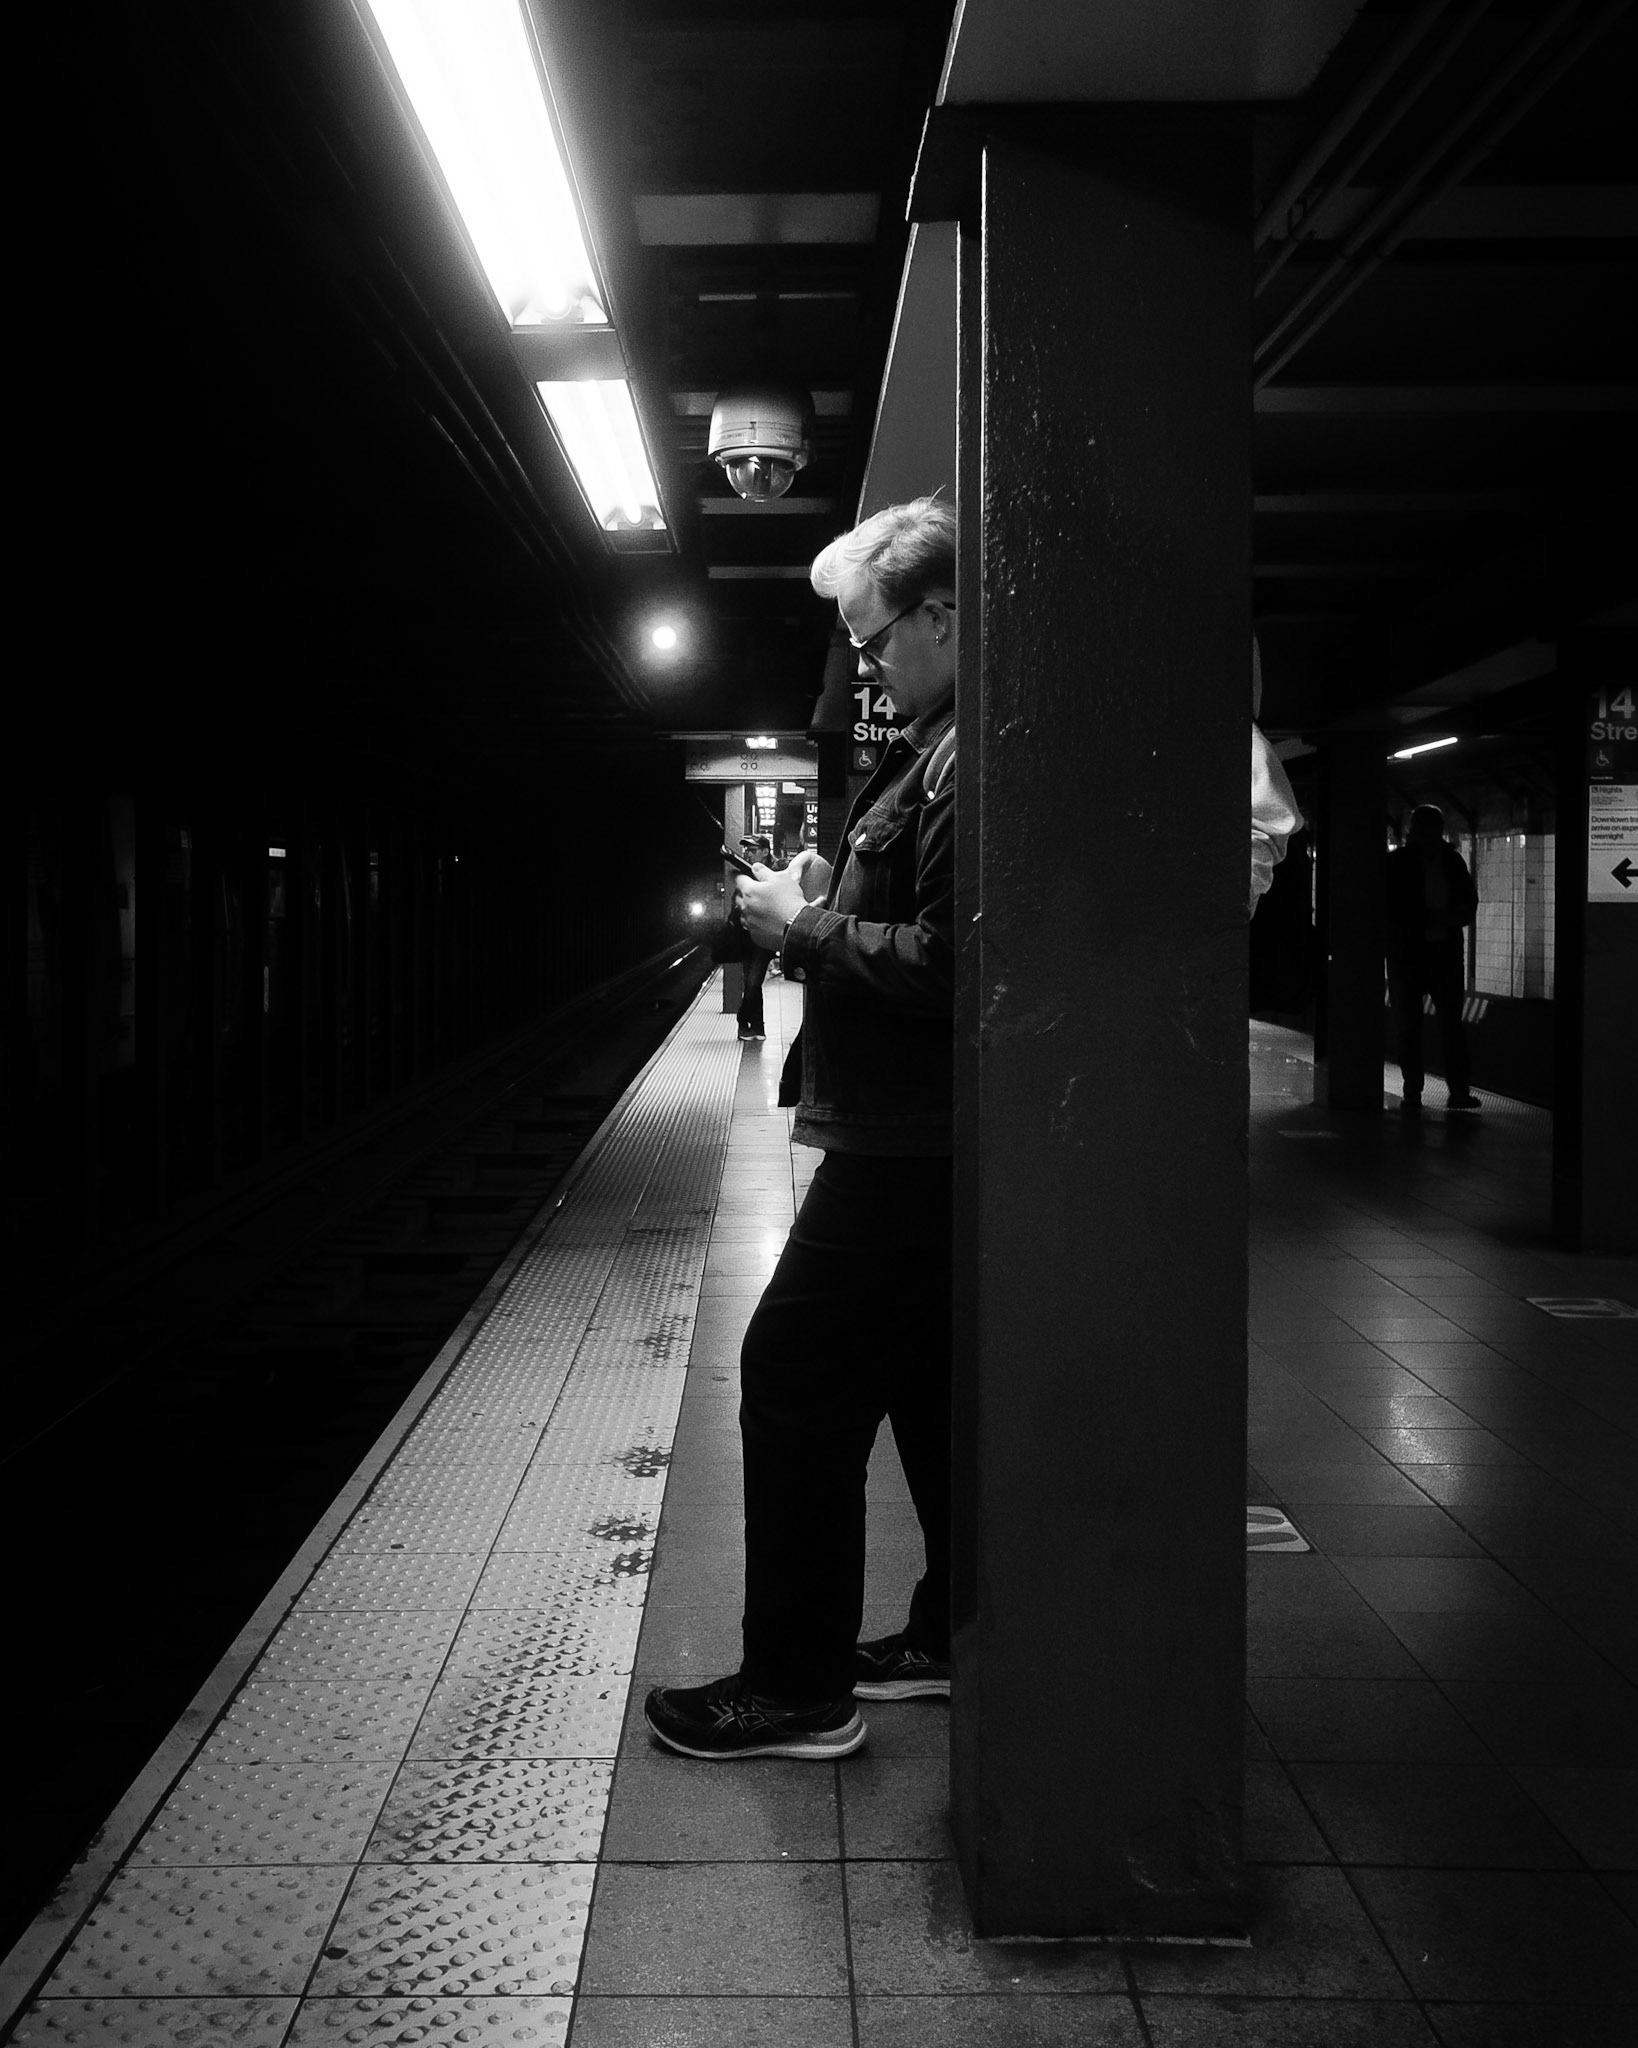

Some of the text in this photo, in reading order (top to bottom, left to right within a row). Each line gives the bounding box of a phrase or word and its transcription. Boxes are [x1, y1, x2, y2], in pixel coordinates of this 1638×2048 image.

[854, 687, 897, 720] 14
[1590, 685, 1637, 719] 14
[1590, 721, 1638, 741] Stre
[1591, 815, 1629, 823] Downtown
[1591, 832, 1624, 841] overnight
